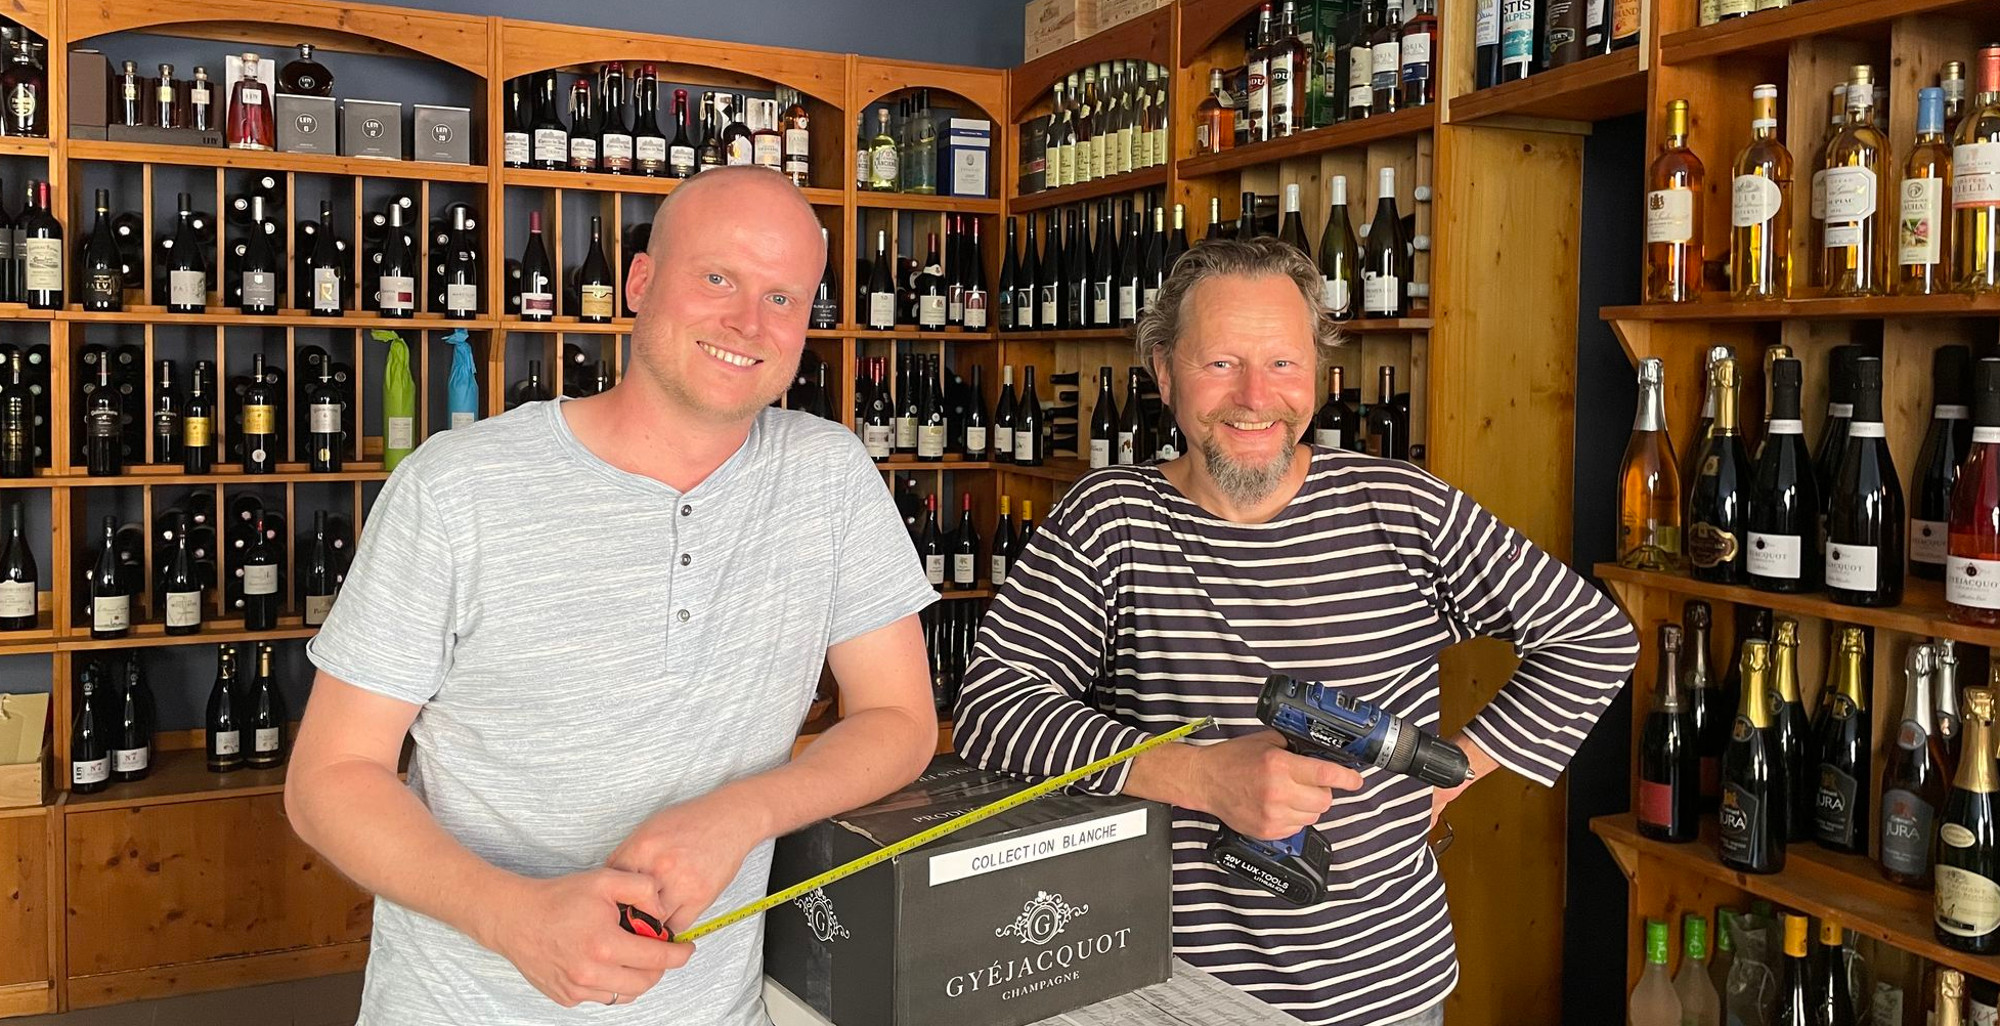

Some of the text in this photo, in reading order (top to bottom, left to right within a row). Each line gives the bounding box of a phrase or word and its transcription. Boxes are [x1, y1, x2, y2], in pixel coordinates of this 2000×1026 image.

[1886, 823, 1921, 843] JURA
[971, 823, 1118, 872] COLLECTION BLANCHE
[1223, 854, 1242, 866] 20V
[1034, 914, 1051, 936] G
[945, 927, 1131, 999] GYÉJACQUOT
[1001, 969, 1081, 1002] CHAMPAGNE
